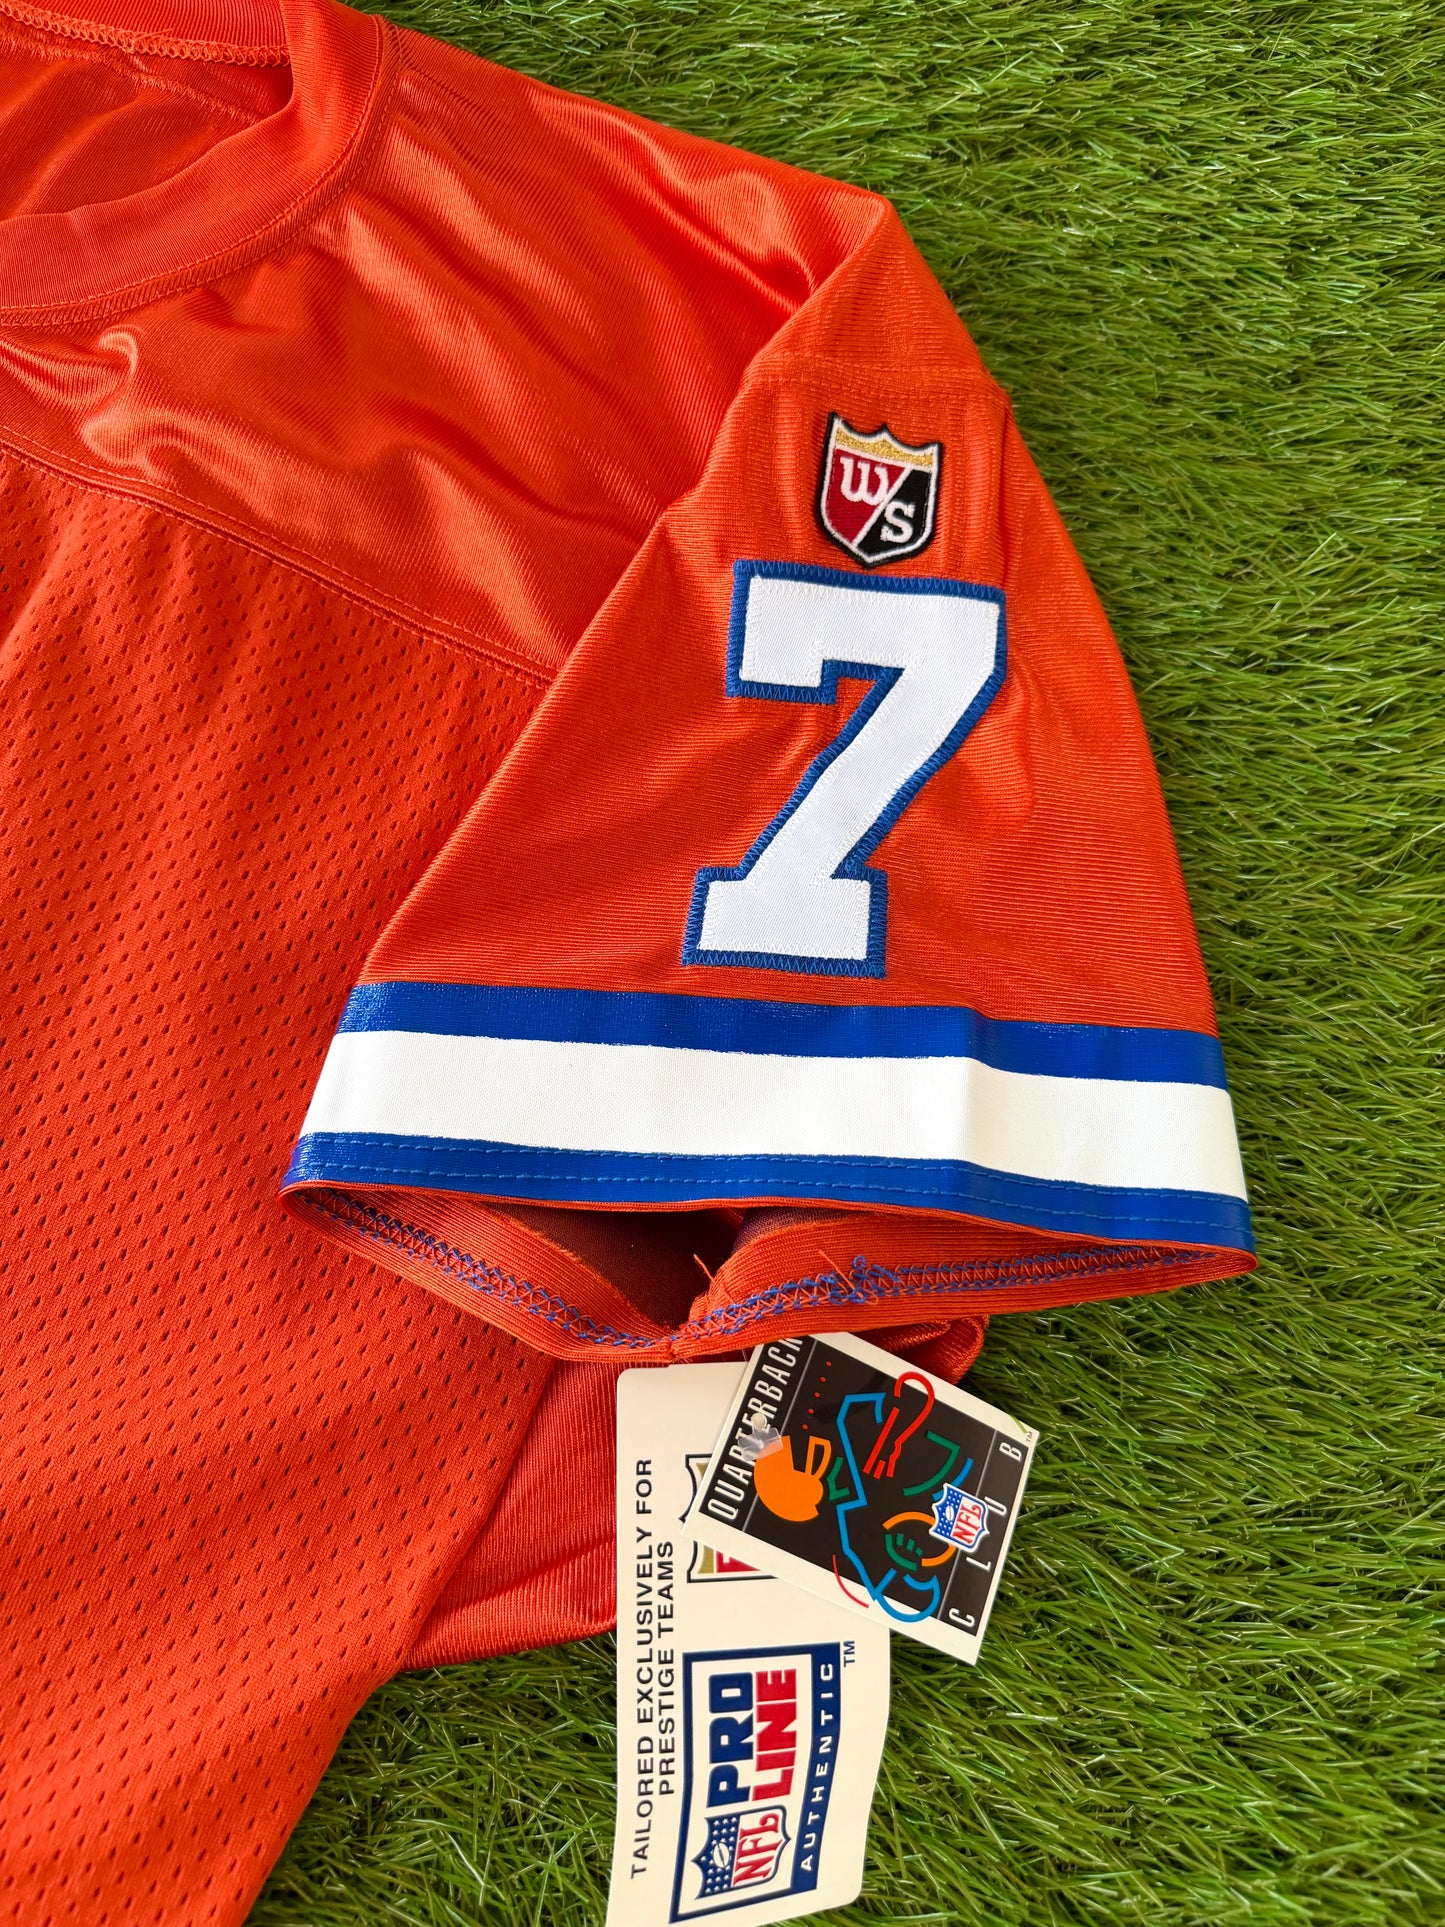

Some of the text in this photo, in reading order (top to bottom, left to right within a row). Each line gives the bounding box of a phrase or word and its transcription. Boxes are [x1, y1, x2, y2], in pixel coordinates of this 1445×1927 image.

[682, 560, 1007, 978] 7
[949, 1441, 1023, 1628] CLUB
[952, 1502, 982, 1545] NFL
[631, 1459, 654, 1879] TAILORED EXCLUSIVELY FOR
[657, 1541, 675, 1795] PRESTIGE TEAMS
[843, 1640, 856, 1668] TM
[706, 1672, 754, 1808] PRO
[752, 1668, 797, 1802] LINE
[800, 1663, 834, 1872] AUTHENTIC
[732, 1812, 783, 1887] NFL
